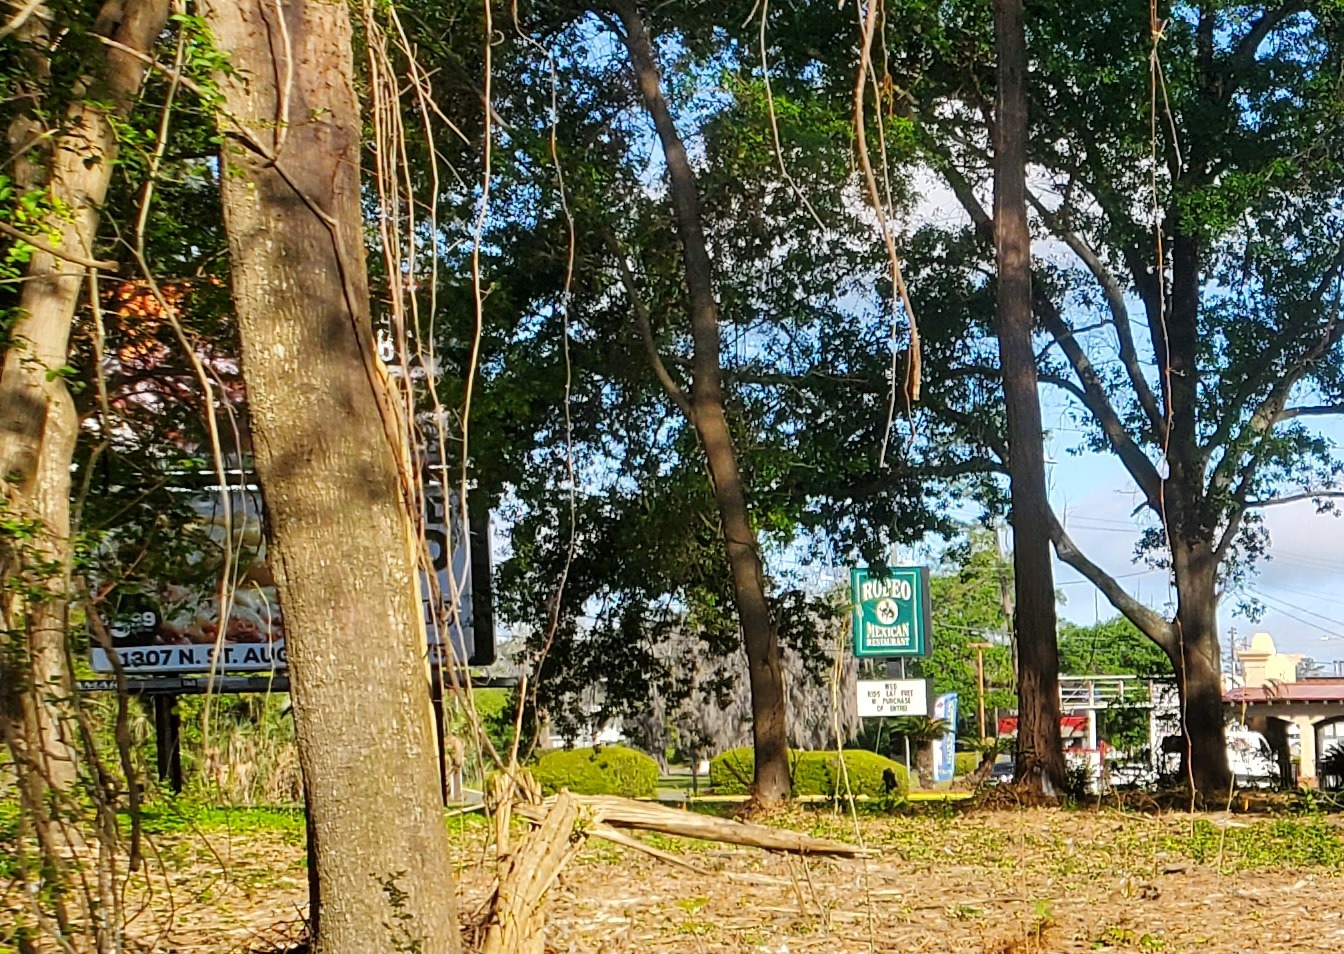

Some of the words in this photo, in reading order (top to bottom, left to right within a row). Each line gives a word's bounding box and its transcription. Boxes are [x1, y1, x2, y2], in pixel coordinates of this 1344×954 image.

[862, 577, 911, 601] RODEO
[866, 621, 909, 638] MEXICAN
[120, 650, 173, 668] 1307
[179, 648, 200, 666] N.
[207, 647, 237, 664] ST.
